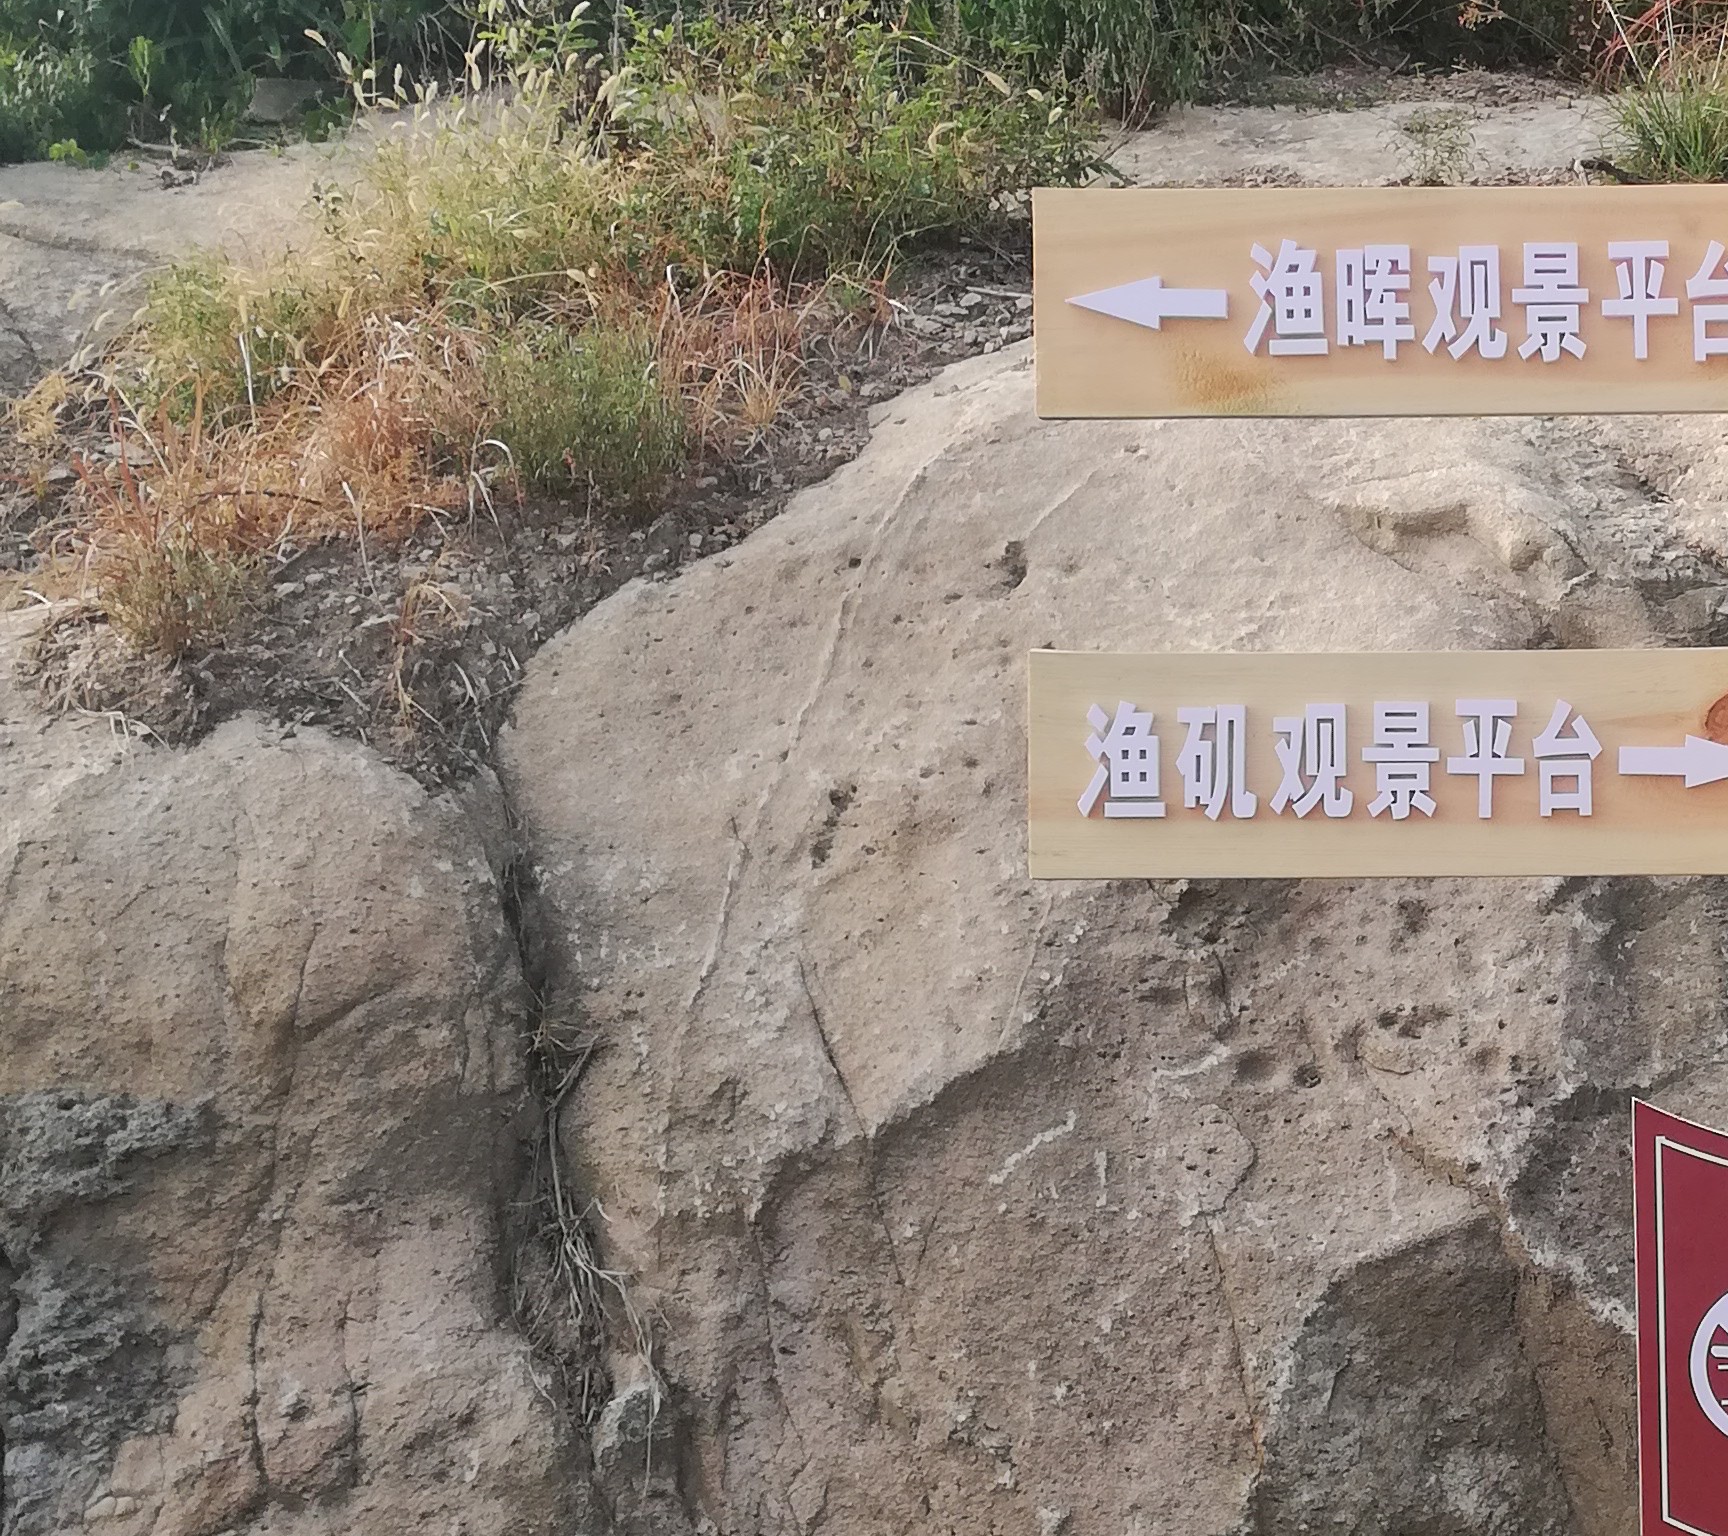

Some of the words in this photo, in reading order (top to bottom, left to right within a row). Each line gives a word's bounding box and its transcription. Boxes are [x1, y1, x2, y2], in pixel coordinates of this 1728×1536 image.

[1077, 699, 1603, 821] 渔矶观景平台
